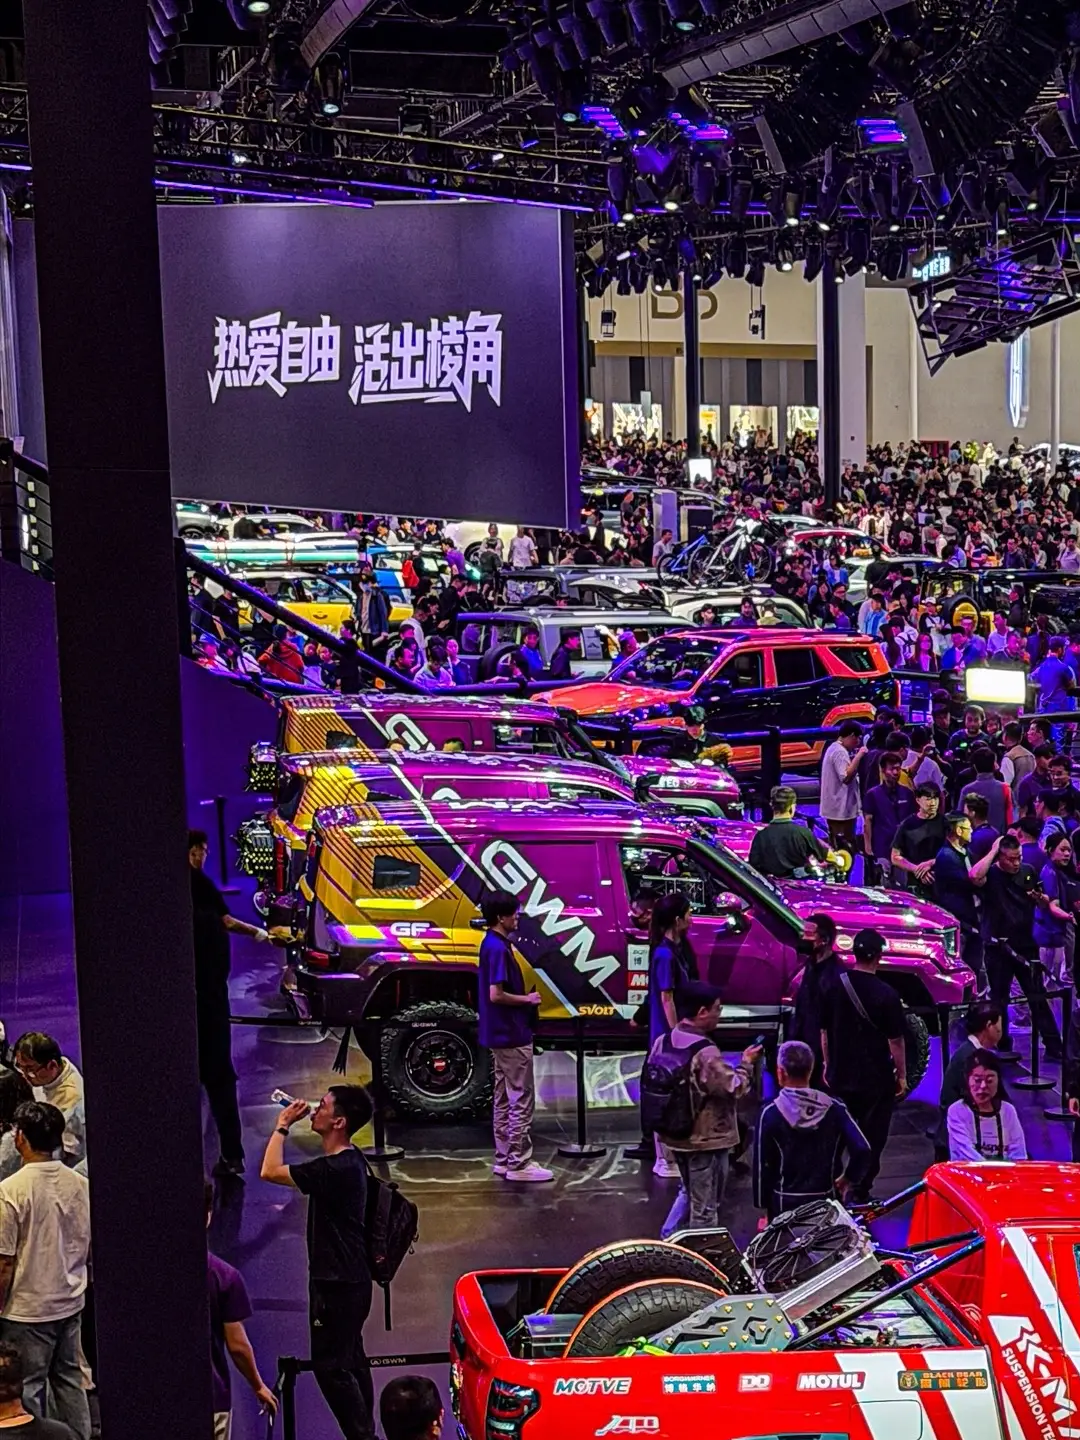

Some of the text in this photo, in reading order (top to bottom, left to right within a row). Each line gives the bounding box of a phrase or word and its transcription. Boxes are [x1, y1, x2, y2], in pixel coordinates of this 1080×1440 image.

[207, 310, 503, 413] 热爱自由 活出棱角
[390, 922, 430, 937] GF
[481, 840, 621, 988] GWM
[799, 1374, 862, 1389] MOTUL
[923, 1371, 954, 1379] BLACK
[1002, 1347, 1048, 1427] SUSPENSION
